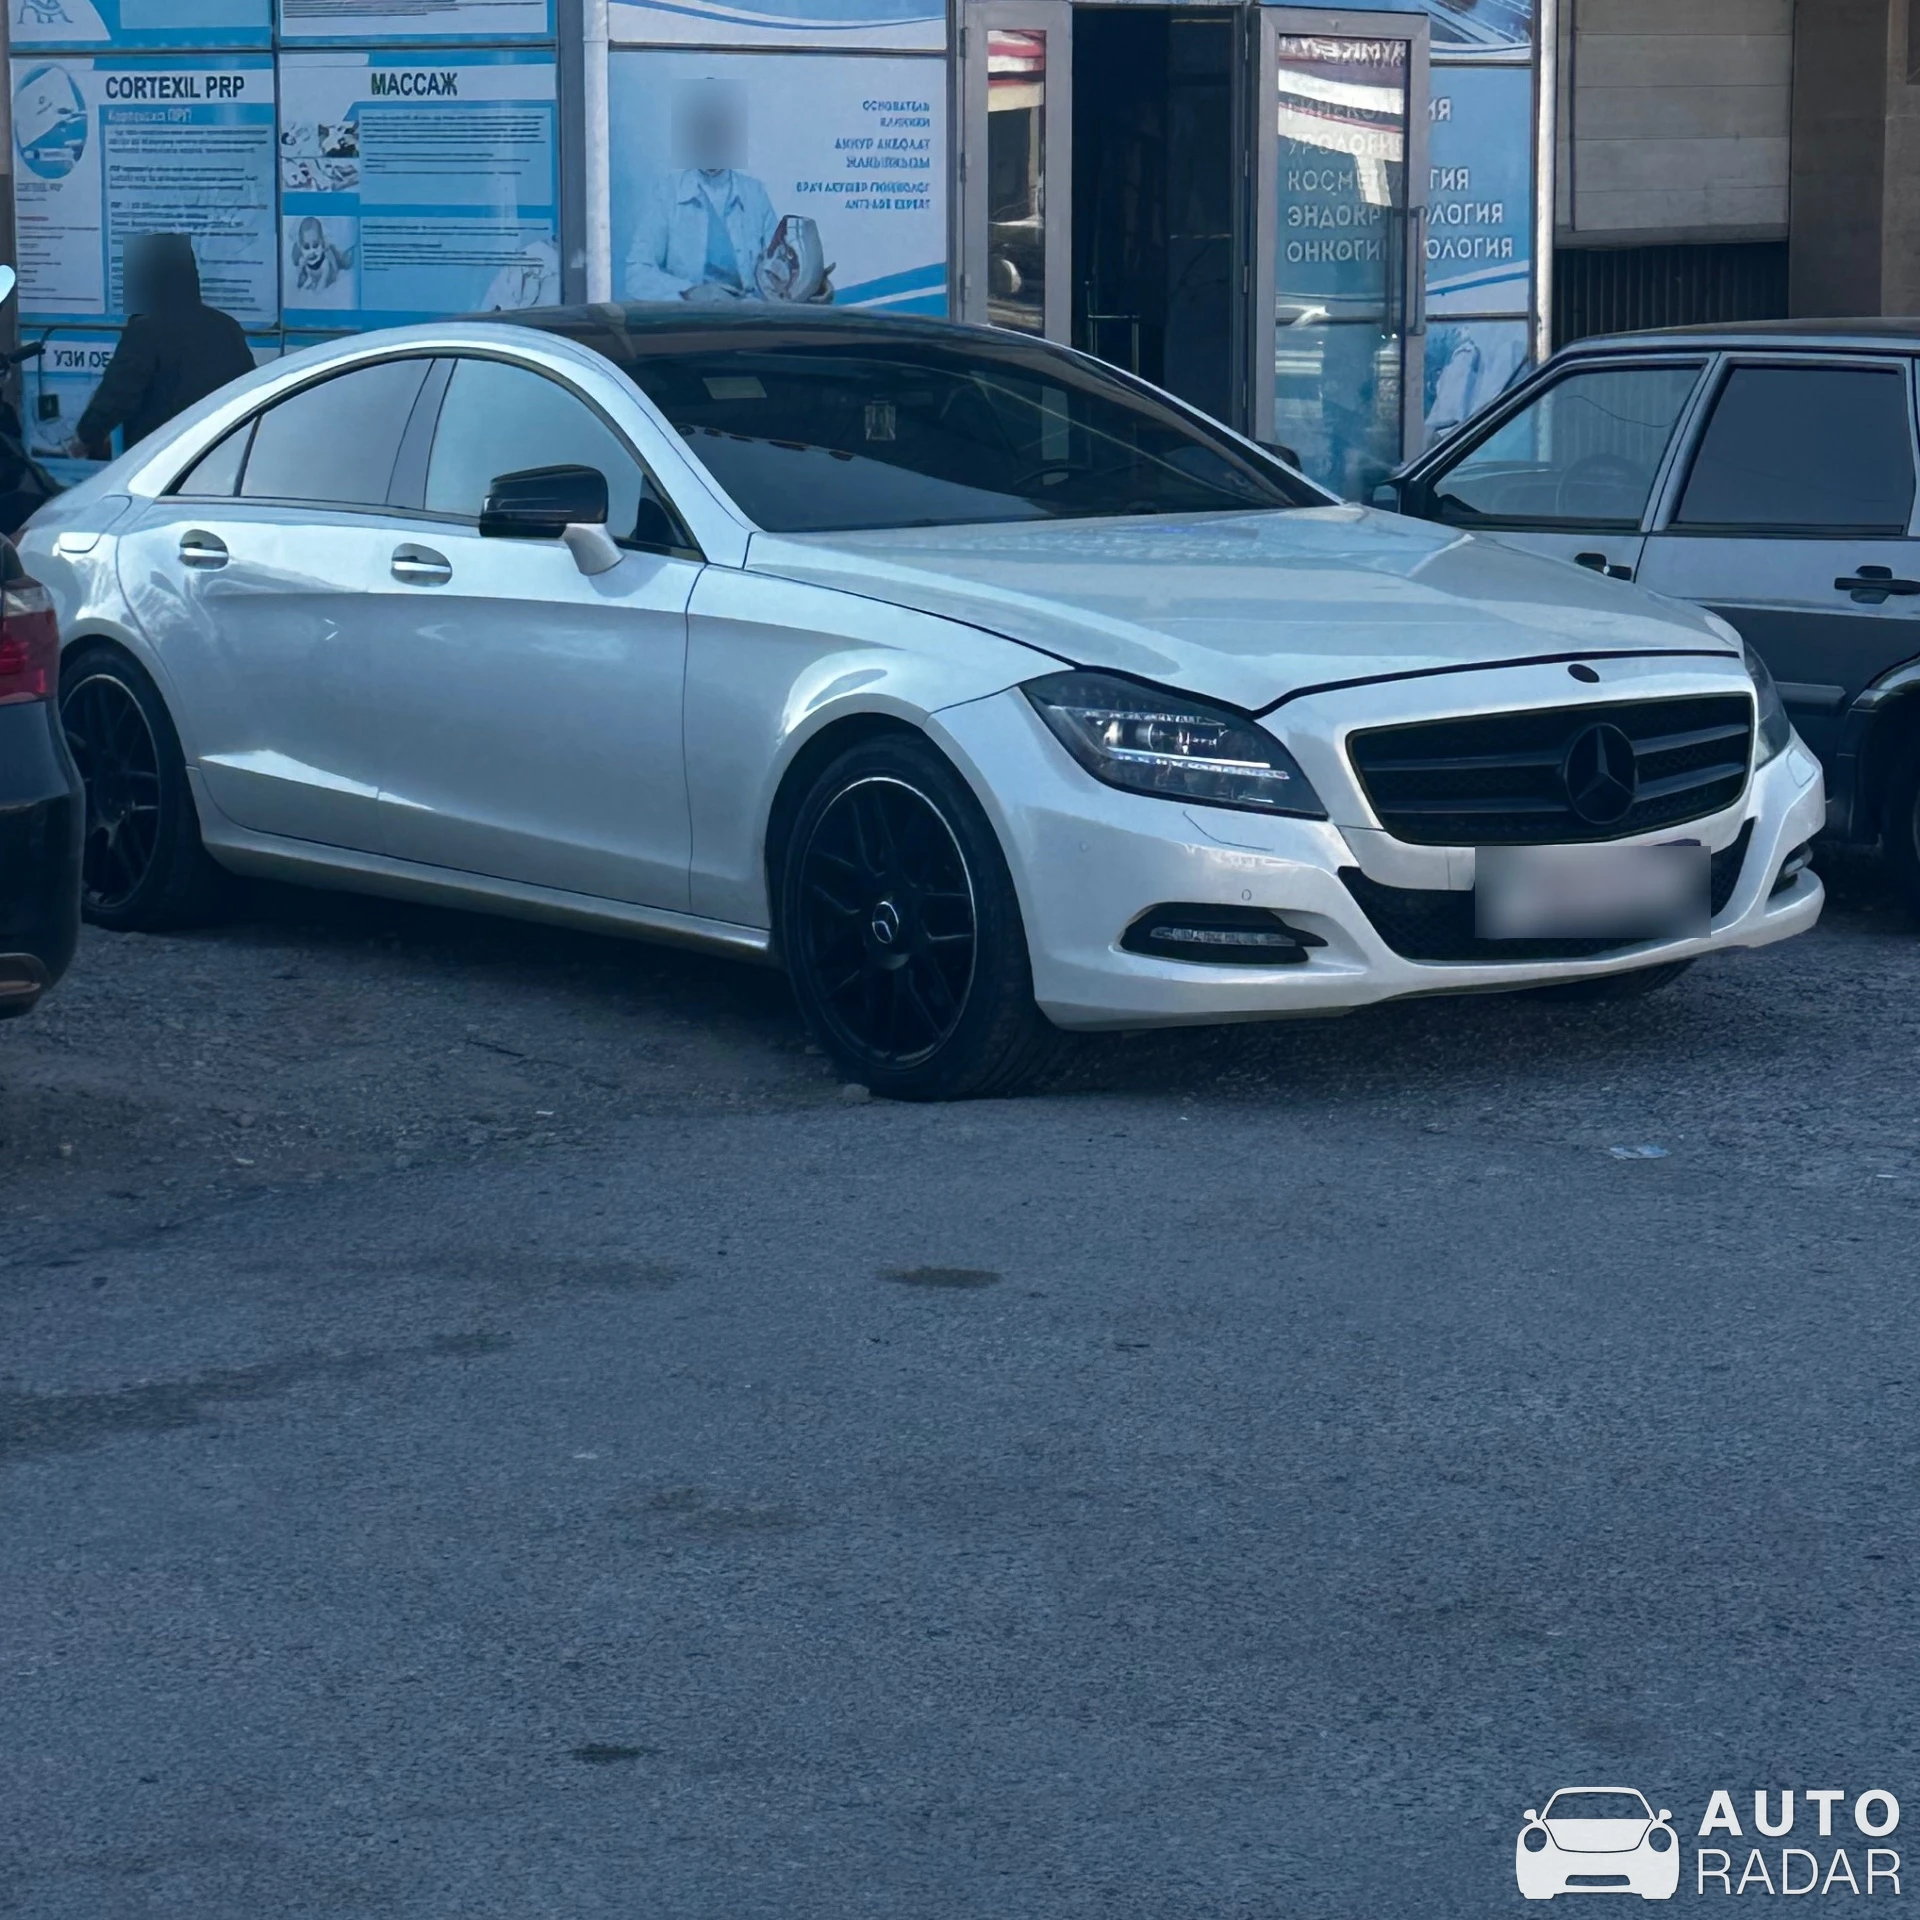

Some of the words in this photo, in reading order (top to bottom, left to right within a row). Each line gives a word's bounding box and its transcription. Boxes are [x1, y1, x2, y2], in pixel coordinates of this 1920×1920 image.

[105, 75, 201, 99] CORTEXIL
[206, 75, 245, 98] PRP
[371, 72, 458, 96] МАССАЖ
[54, 350, 85, 367] УЗИ
